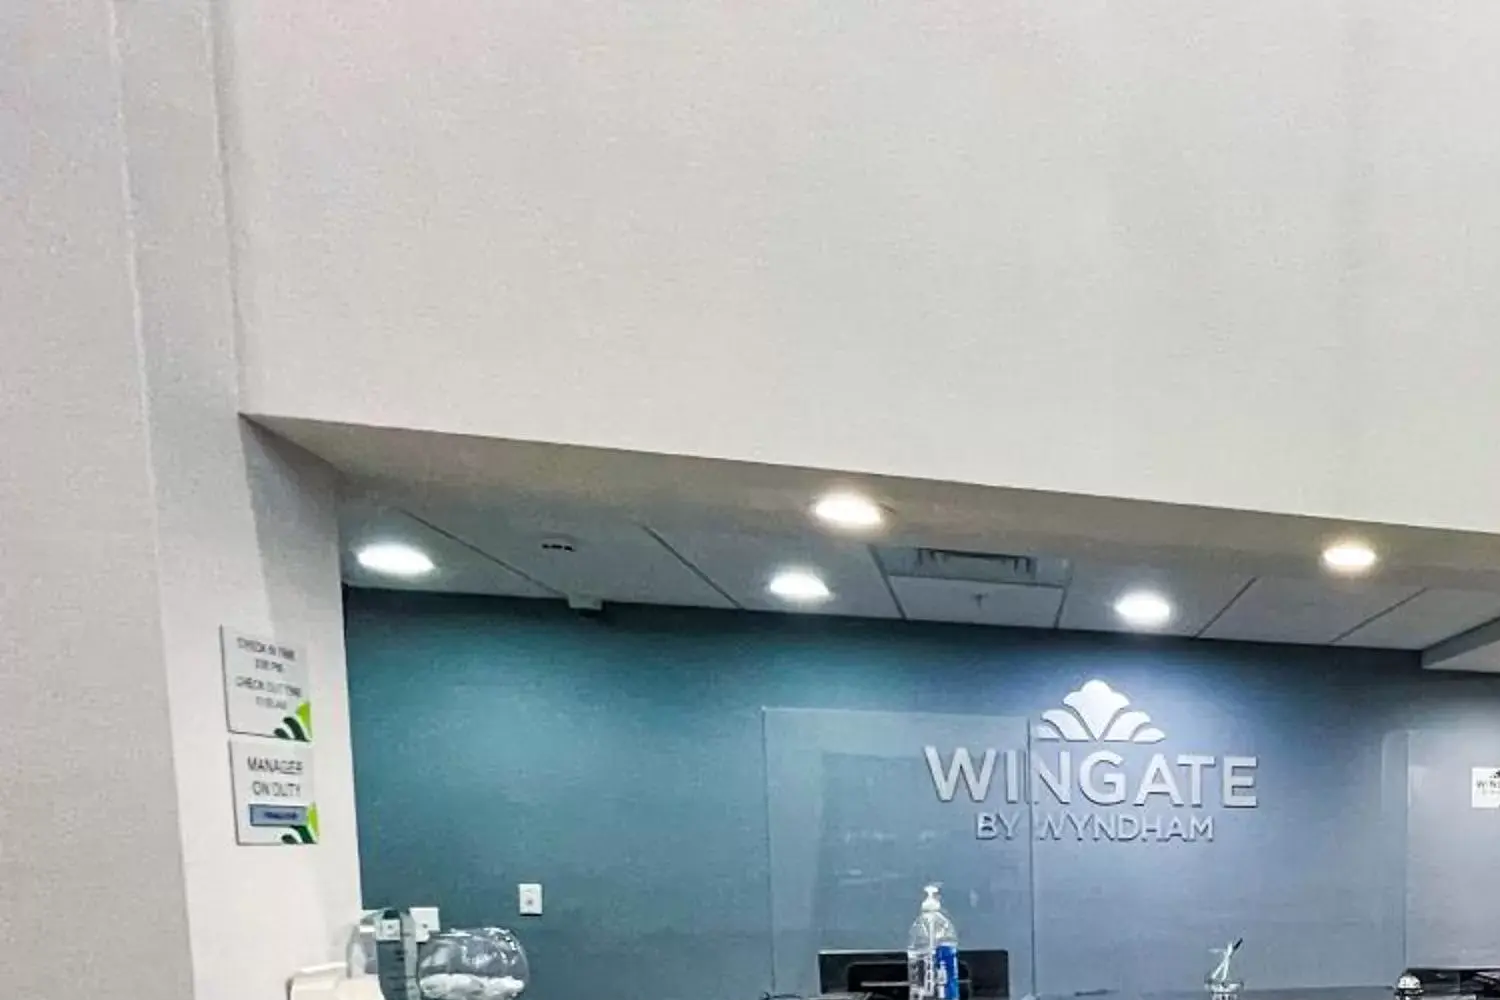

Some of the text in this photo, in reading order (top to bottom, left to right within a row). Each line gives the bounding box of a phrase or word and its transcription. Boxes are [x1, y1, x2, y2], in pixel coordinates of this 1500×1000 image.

[924, 744, 1259, 809] WINGATE
[975, 811, 1215, 842] BY WYNDHAM
